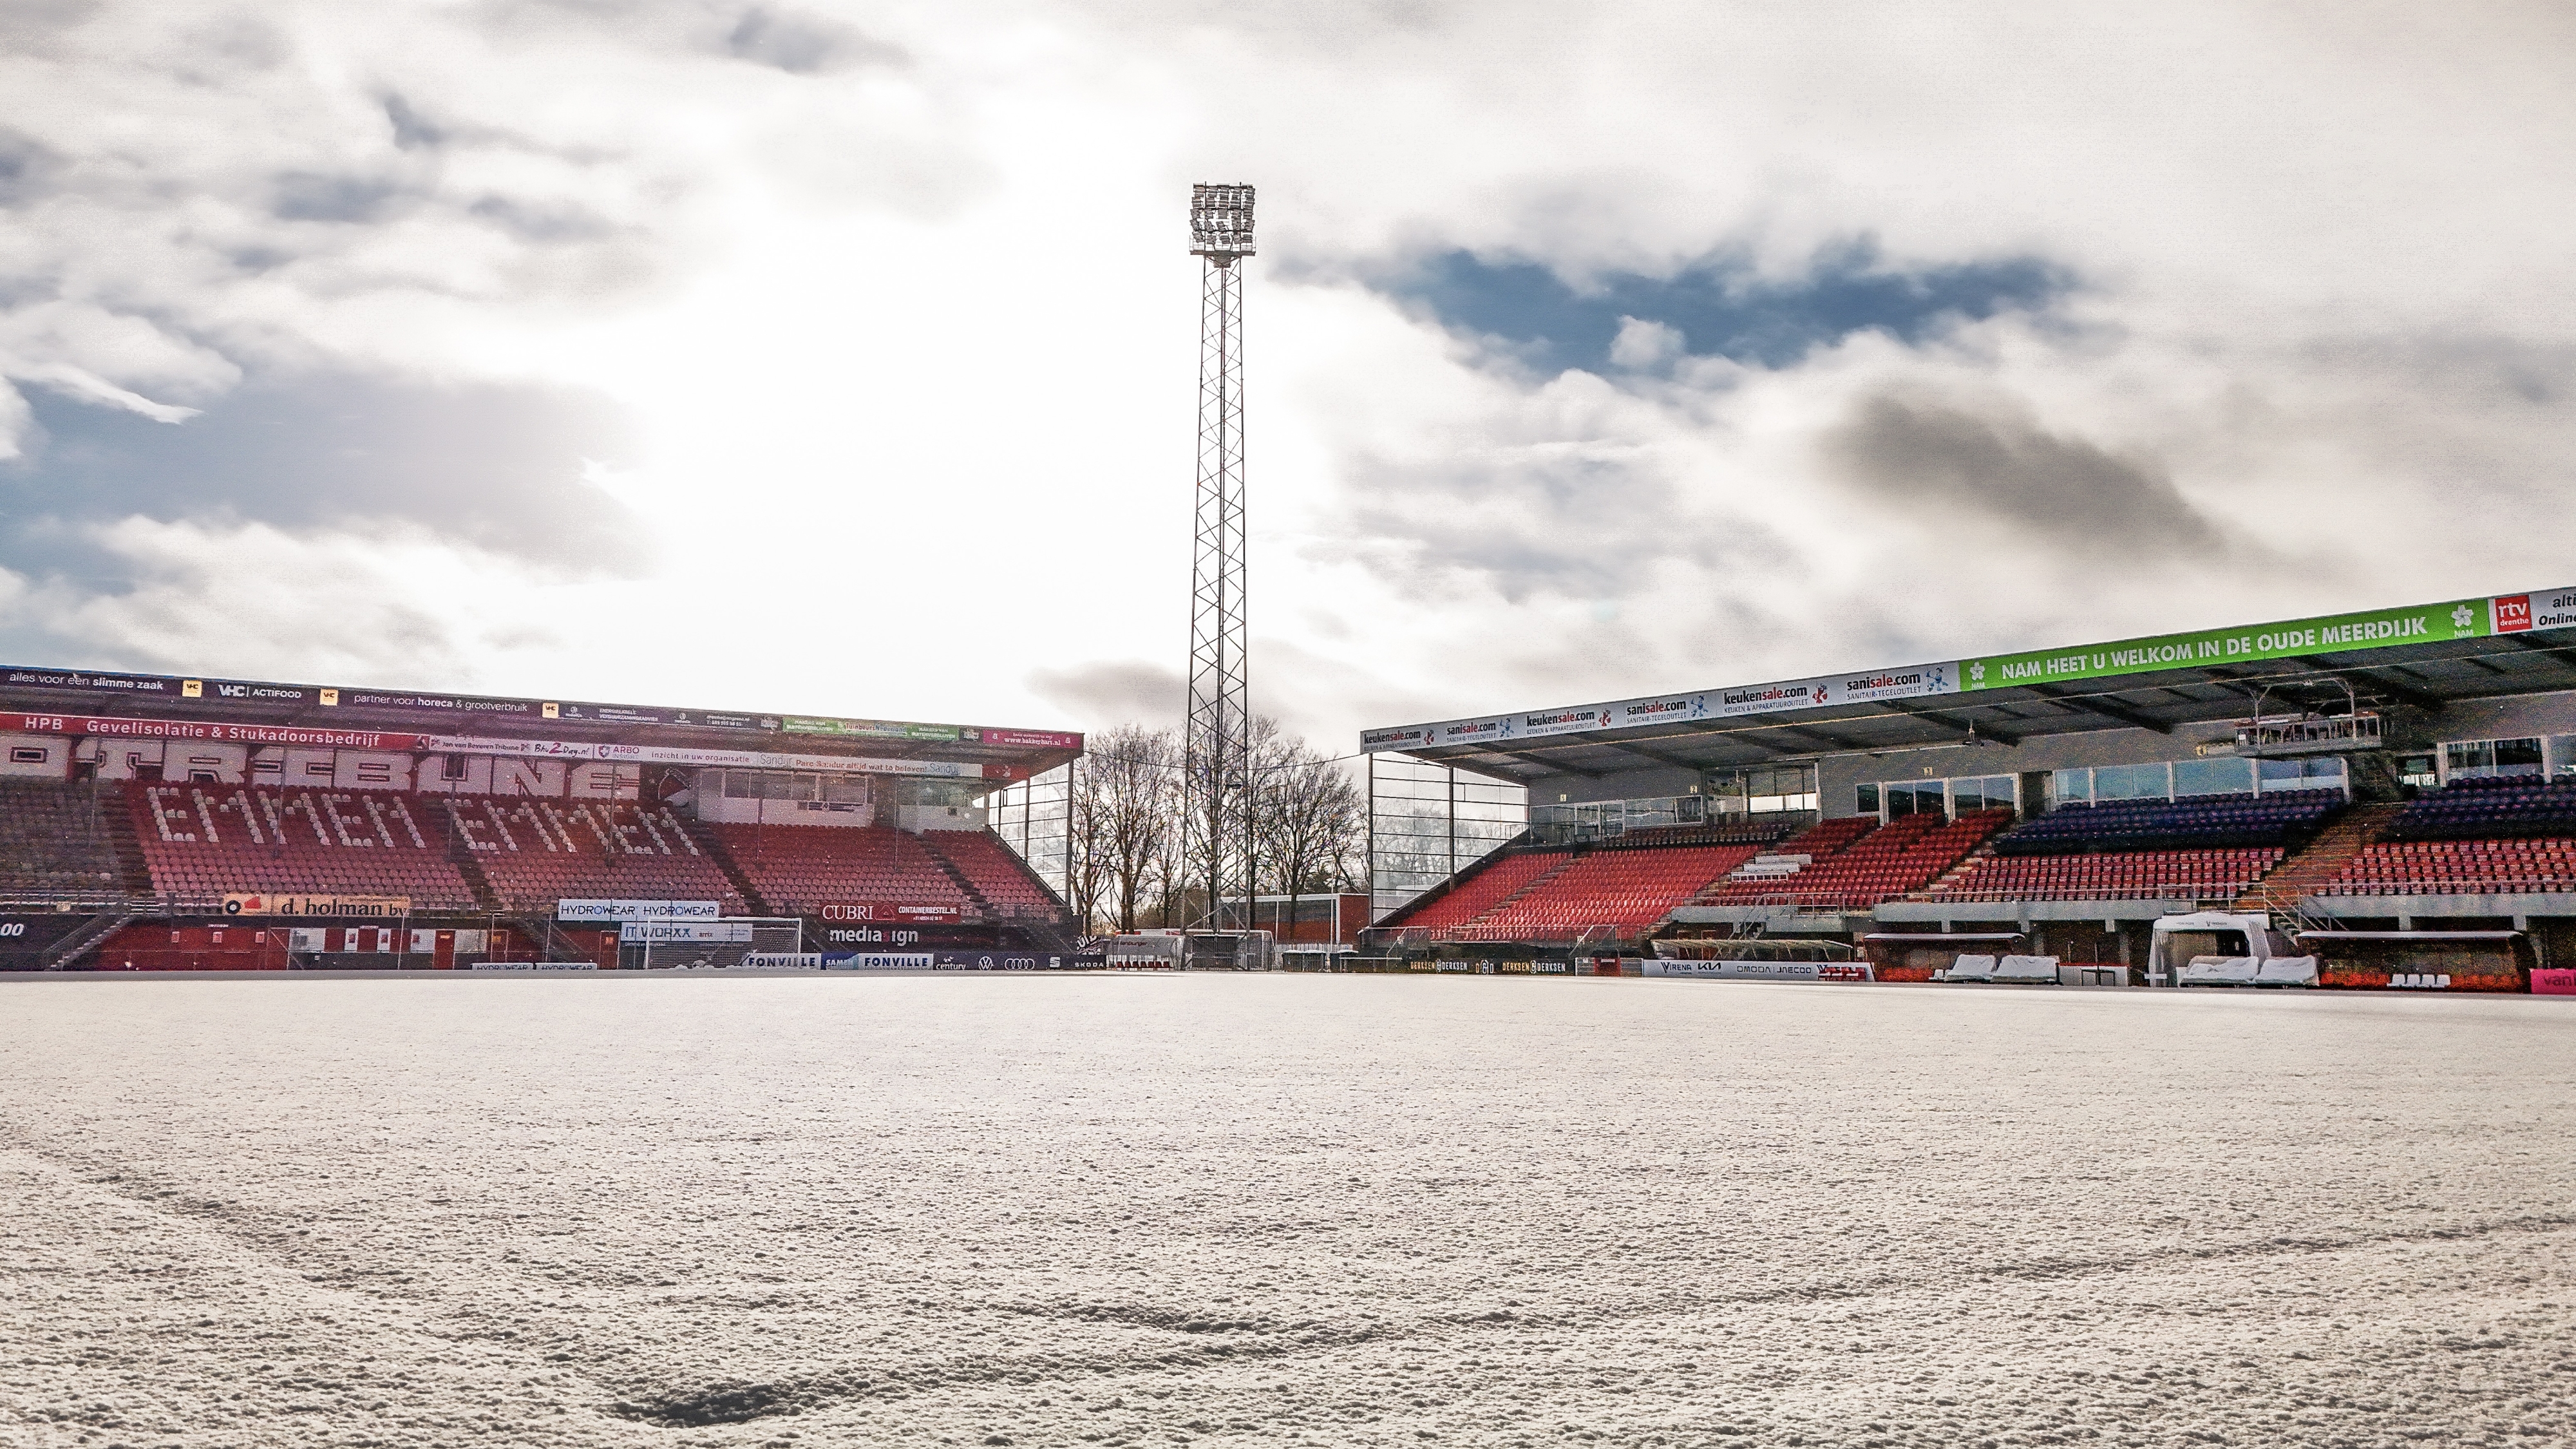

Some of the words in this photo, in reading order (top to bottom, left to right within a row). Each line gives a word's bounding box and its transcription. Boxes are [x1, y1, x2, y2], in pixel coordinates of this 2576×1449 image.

[2499, 603, 2526, 618] rtv
[2500, 616, 2529, 627] drenthe
[2454, 629, 2473, 638] NAM
[2002, 661, 2041, 679] NAM
[2047, 656, 2087, 674] HEET
[2093, 654, 2105, 669] U
[2111, 643, 2193, 667] WELKOM
[2198, 640, 2219, 659] IN
[2227, 637, 2250, 654] DE
[2257, 629, 2315, 652] OUDE
[2322, 616, 2427, 644] MEERDIJK
[10, 672, 35, 683] alles
[39, 675, 65, 685] voor
[93, 677, 133, 688] slimme
[137, 681, 163, 690] zaak
[1848, 673, 1920, 691] sanisale.com
[218, 685, 245, 697] VHC
[253, 688, 301, 698] ACTIFOOD
[1724, 686, 1807, 705] keukensale.com
[1848, 686, 1920, 700] SANITAIR-TEGELOUTLET
[354, 695, 390, 705] partner
[393, 697, 415, 706] voor
[418, 698, 453, 708] horeca
[466, 701, 527, 712] grootverbruik
[1627, 701, 1686, 715] sanisale.com
[1526, 710, 1595, 726] keukensale.com
[1627, 712, 1686, 724] SANITAIR-TEGELOUTLET
[25, 717, 62, 730] HPB
[86, 720, 204, 737] Gevelisolatie
[211, 726, 222, 738] &
[229, 727, 379, 748] Stukadoorsbedrijf
[1447, 722, 1495, 735] sanisale.com
[1365, 730, 1421, 744] keukensale.com
[705, 755, 749, 764] organisatie
[282, 898, 299, 915] d.
[305, 898, 383, 916] holman
[561, 905, 636, 915] HYDROWEAR
[644, 906, 715, 916] HYDROWEAR
[822, 905, 873, 920] CUBRI
[898, 905, 957, 914] CONTAINERBESTEL.NL
[625, 926, 636, 937] IT
[748, 957, 815, 967] FONVILLE
[864, 958, 928, 967] FONVILLE
[936, 961, 965, 971] century
[1443, 961, 1467, 971] DERKSEN
[1502, 962, 1530, 971] DERKSEN
[1537, 963, 1565, 972] DERKSEN
[1661, 961, 1692, 973] VIRENA
